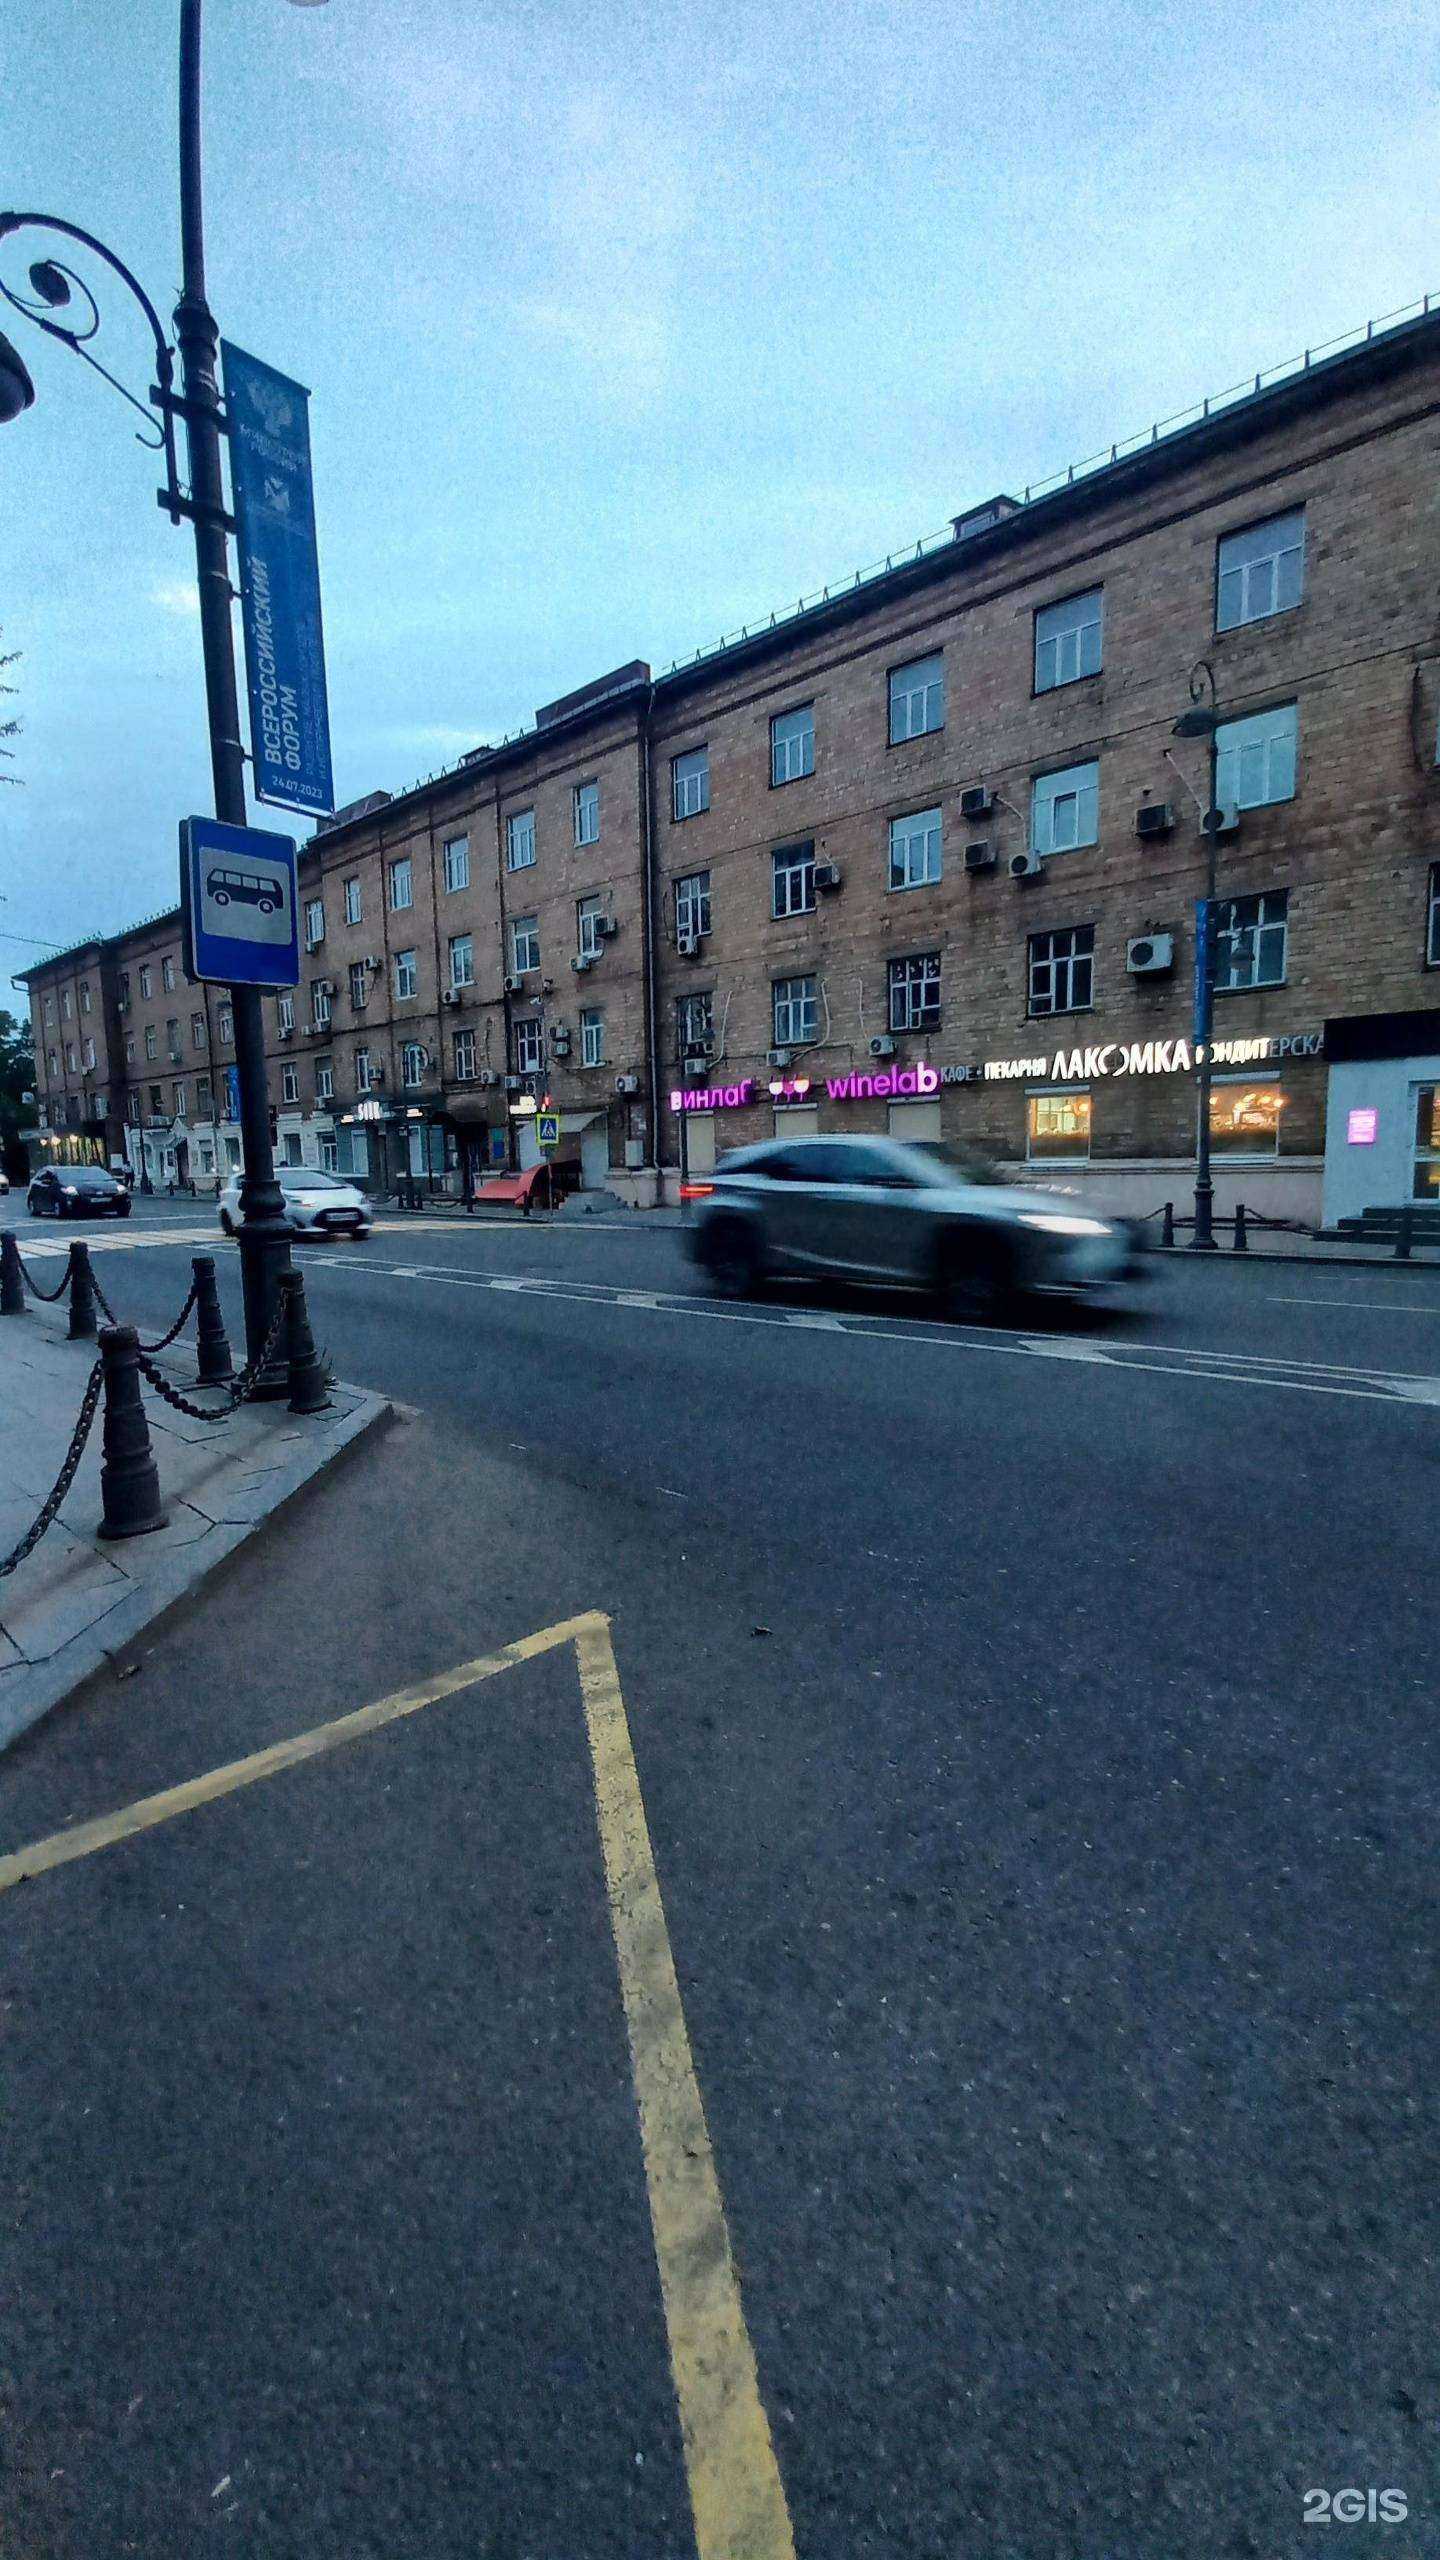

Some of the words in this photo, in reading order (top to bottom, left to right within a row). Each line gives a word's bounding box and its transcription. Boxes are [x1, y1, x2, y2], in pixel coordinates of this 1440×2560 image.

[247, 555, 282, 765] ВСЕРОССИЙСКИЙ
[279, 685, 302, 772] ФОРУМ
[271, 774, 323, 799] 24.07.2023
[825, 1061, 938, 1099] winelab
[940, 1065, 976, 1082] КАФЕ
[984, 1057, 1047, 1080] ПЕКАРНЯ
[1051, 1038, 1191, 1080] ЛАКОМКА
